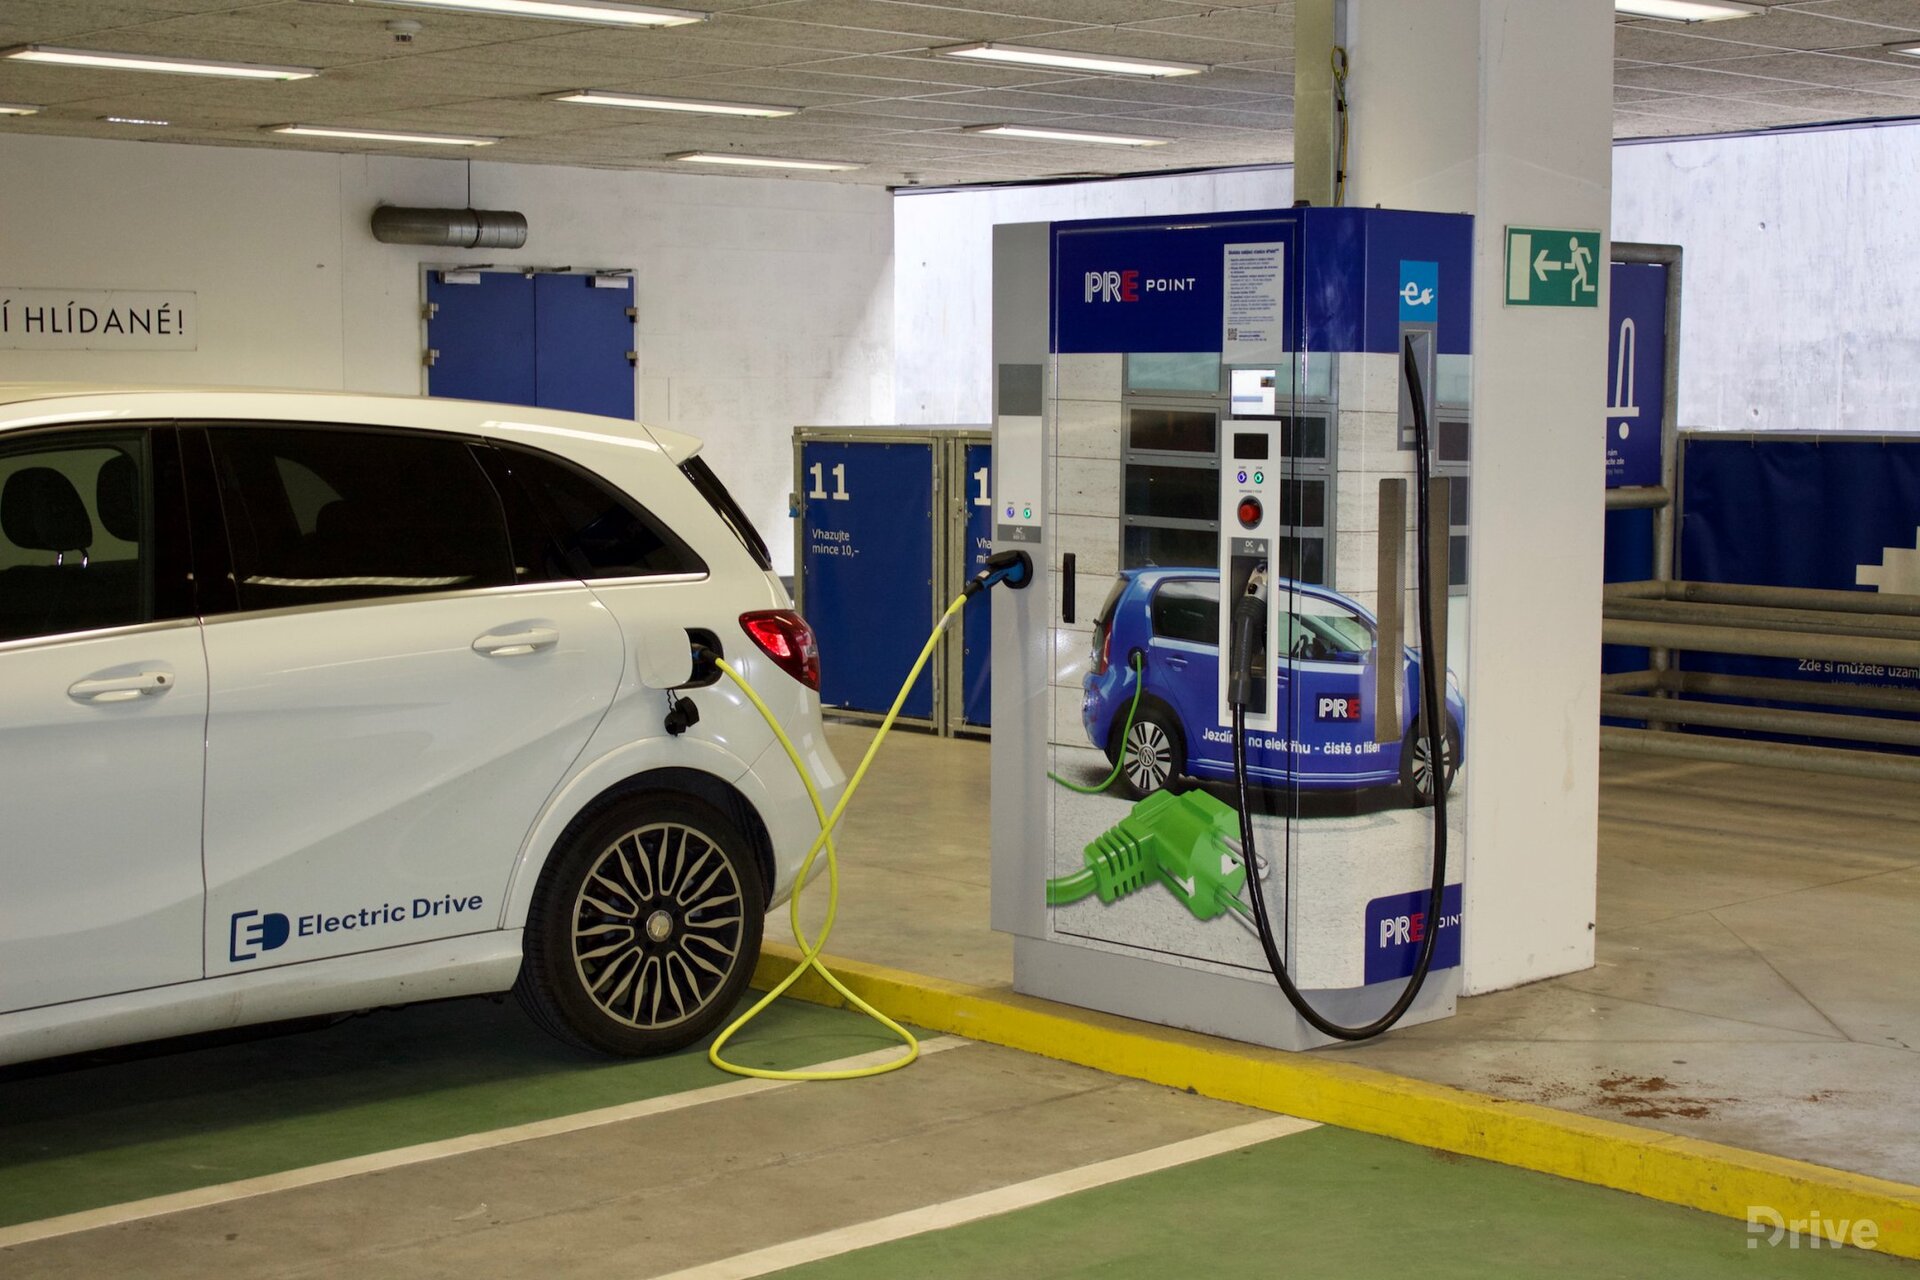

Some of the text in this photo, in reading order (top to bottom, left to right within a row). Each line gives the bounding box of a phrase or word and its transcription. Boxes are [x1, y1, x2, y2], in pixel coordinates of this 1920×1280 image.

[1085, 271, 1195, 302] PRE POINT
[25, 301, 183, 335] HLÍDANÉ!
[809, 462, 850, 500] 11
[812, 529, 850, 543] Vhazujte
[812, 545, 839, 555] mince
[1798, 658, 1821, 672] Zde
[1824, 661, 1833, 673] si
[1319, 698, 1361, 718] PRE
[1248, 736, 1262, 748] na
[1265, 738, 1311, 754] elekřinu
[1324, 740, 1351, 754] čistě
[1355, 744, 1362, 754] a
[298, 903, 405, 937] Electric
[412, 894, 483, 919] Drive
[1380, 913, 1424, 948] PRE
